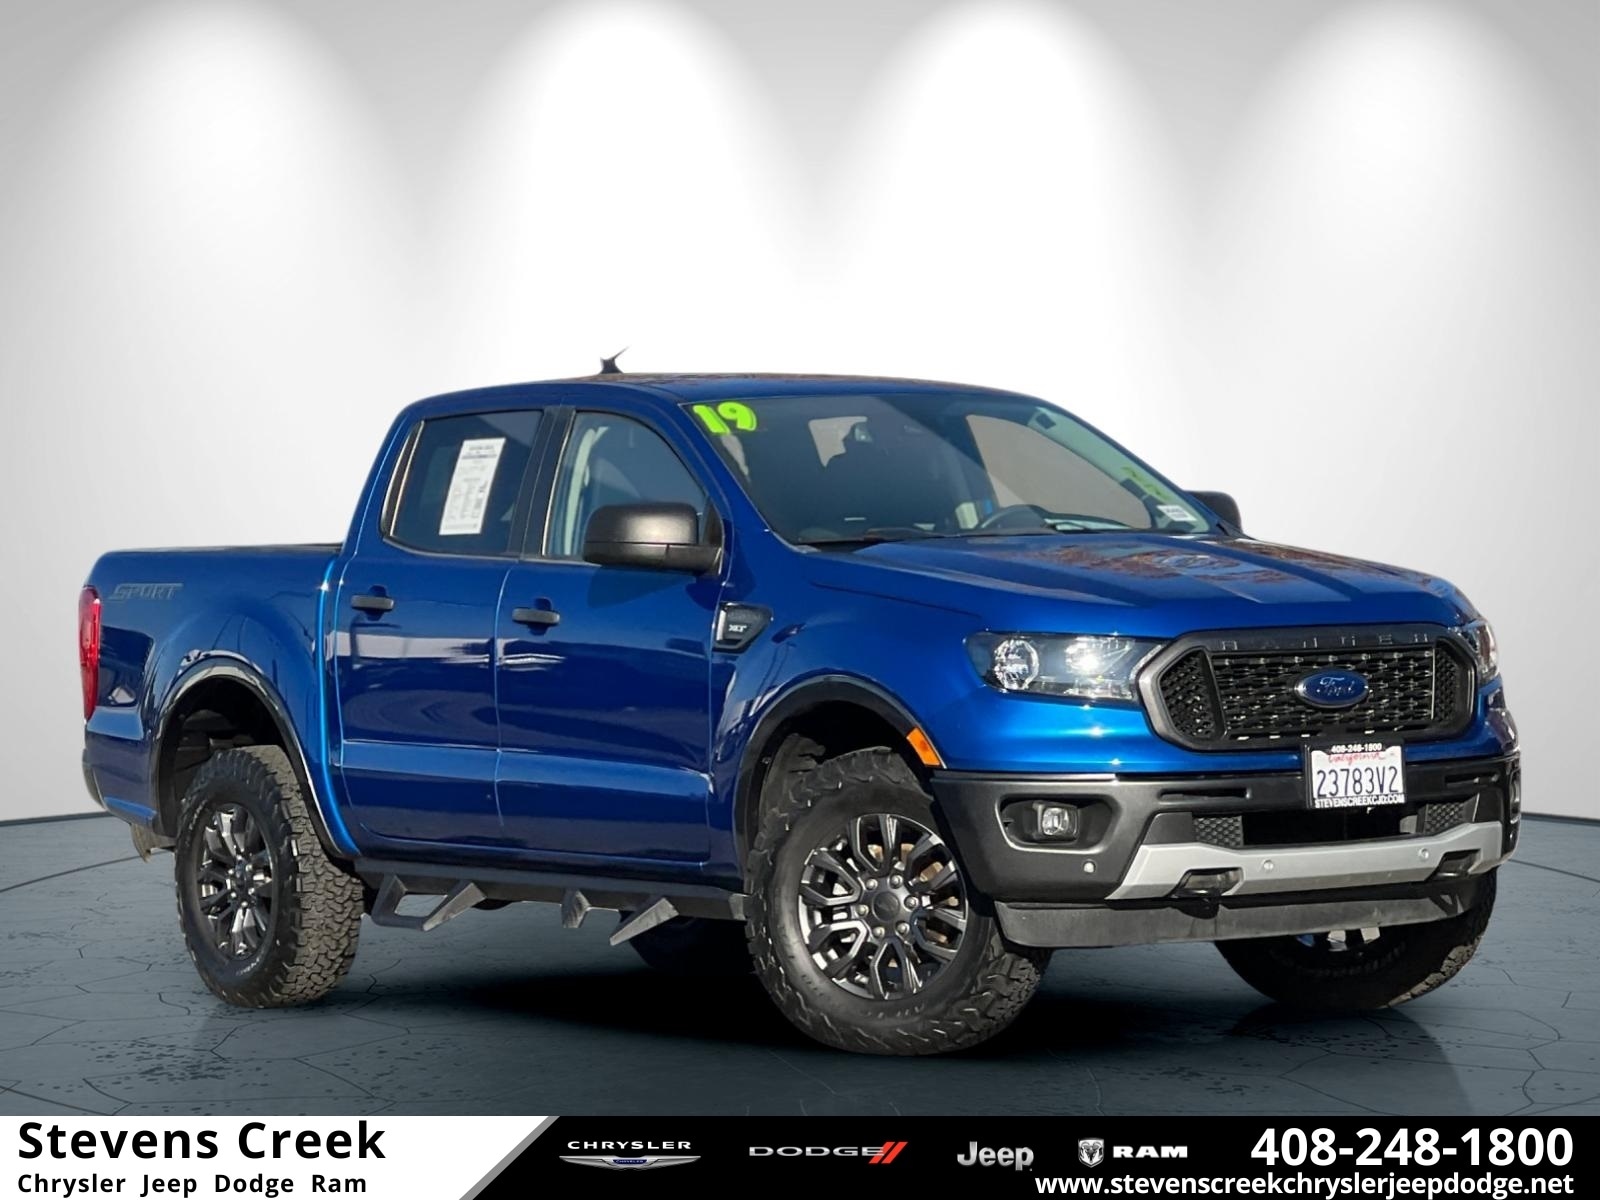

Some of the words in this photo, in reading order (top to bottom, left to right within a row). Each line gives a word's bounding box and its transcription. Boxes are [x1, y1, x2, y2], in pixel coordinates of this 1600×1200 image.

[692, 401, 757, 434] 19
[108, 582, 184, 600] SPORT
[728, 624, 748, 633] XLT
[1330, 742, 1383, 754] 408-248-1800
[1316, 765, 1399, 799] 23783V2
